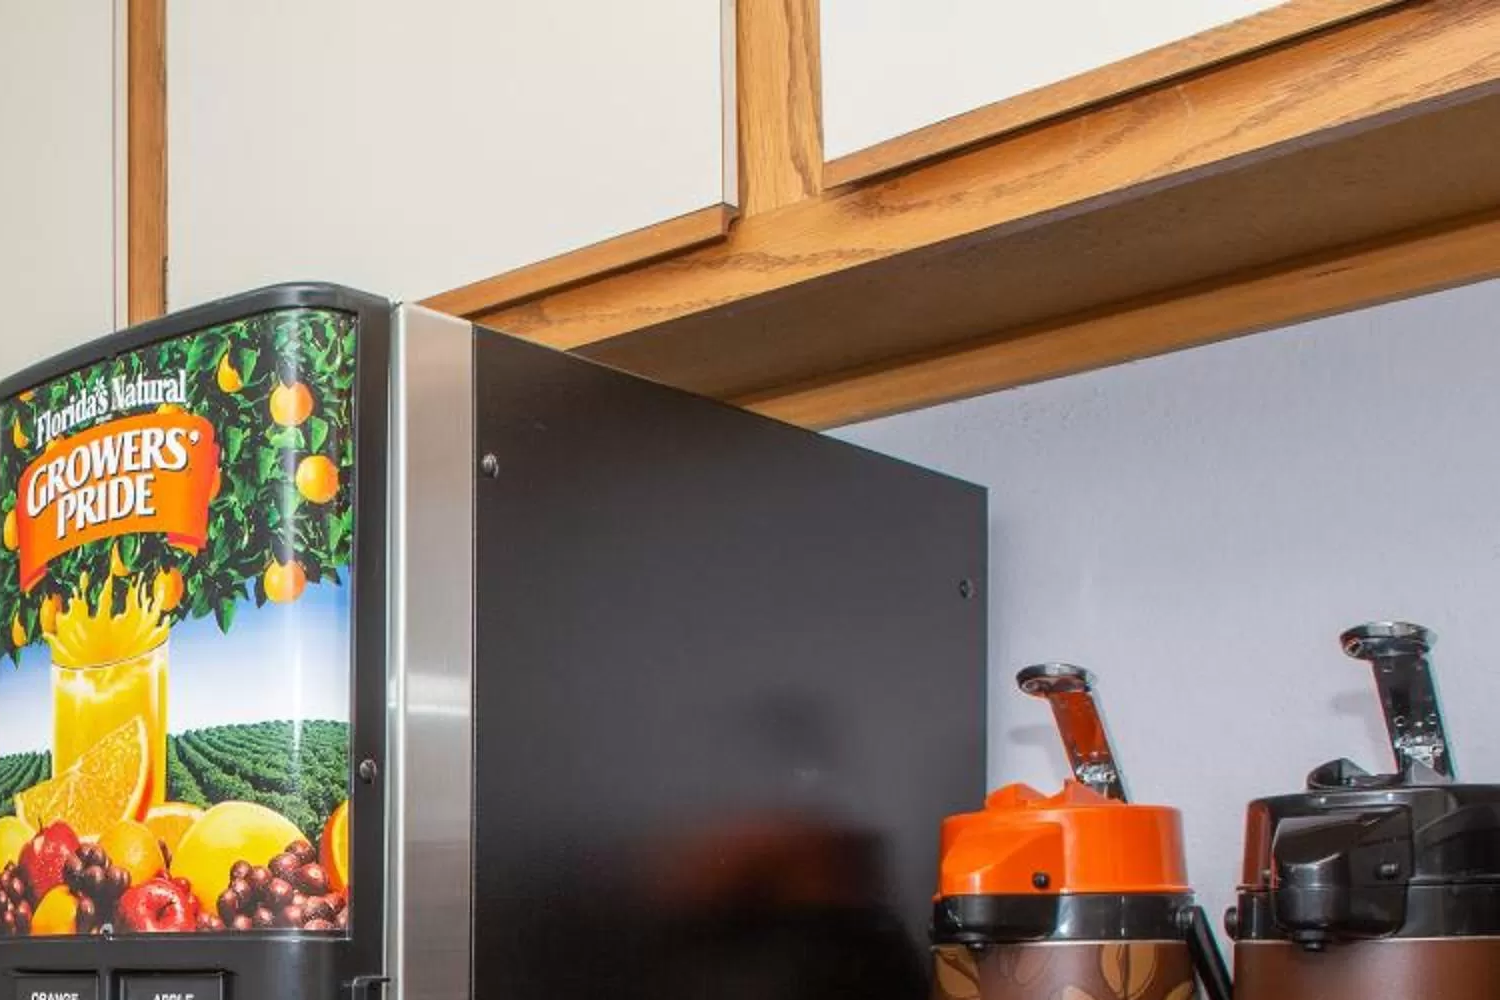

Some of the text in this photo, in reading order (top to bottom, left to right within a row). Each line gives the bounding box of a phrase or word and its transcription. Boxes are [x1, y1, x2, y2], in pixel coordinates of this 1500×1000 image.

[34, 369, 187, 450] Florida's Natural
[56, 473, 157, 540] PRIDE
